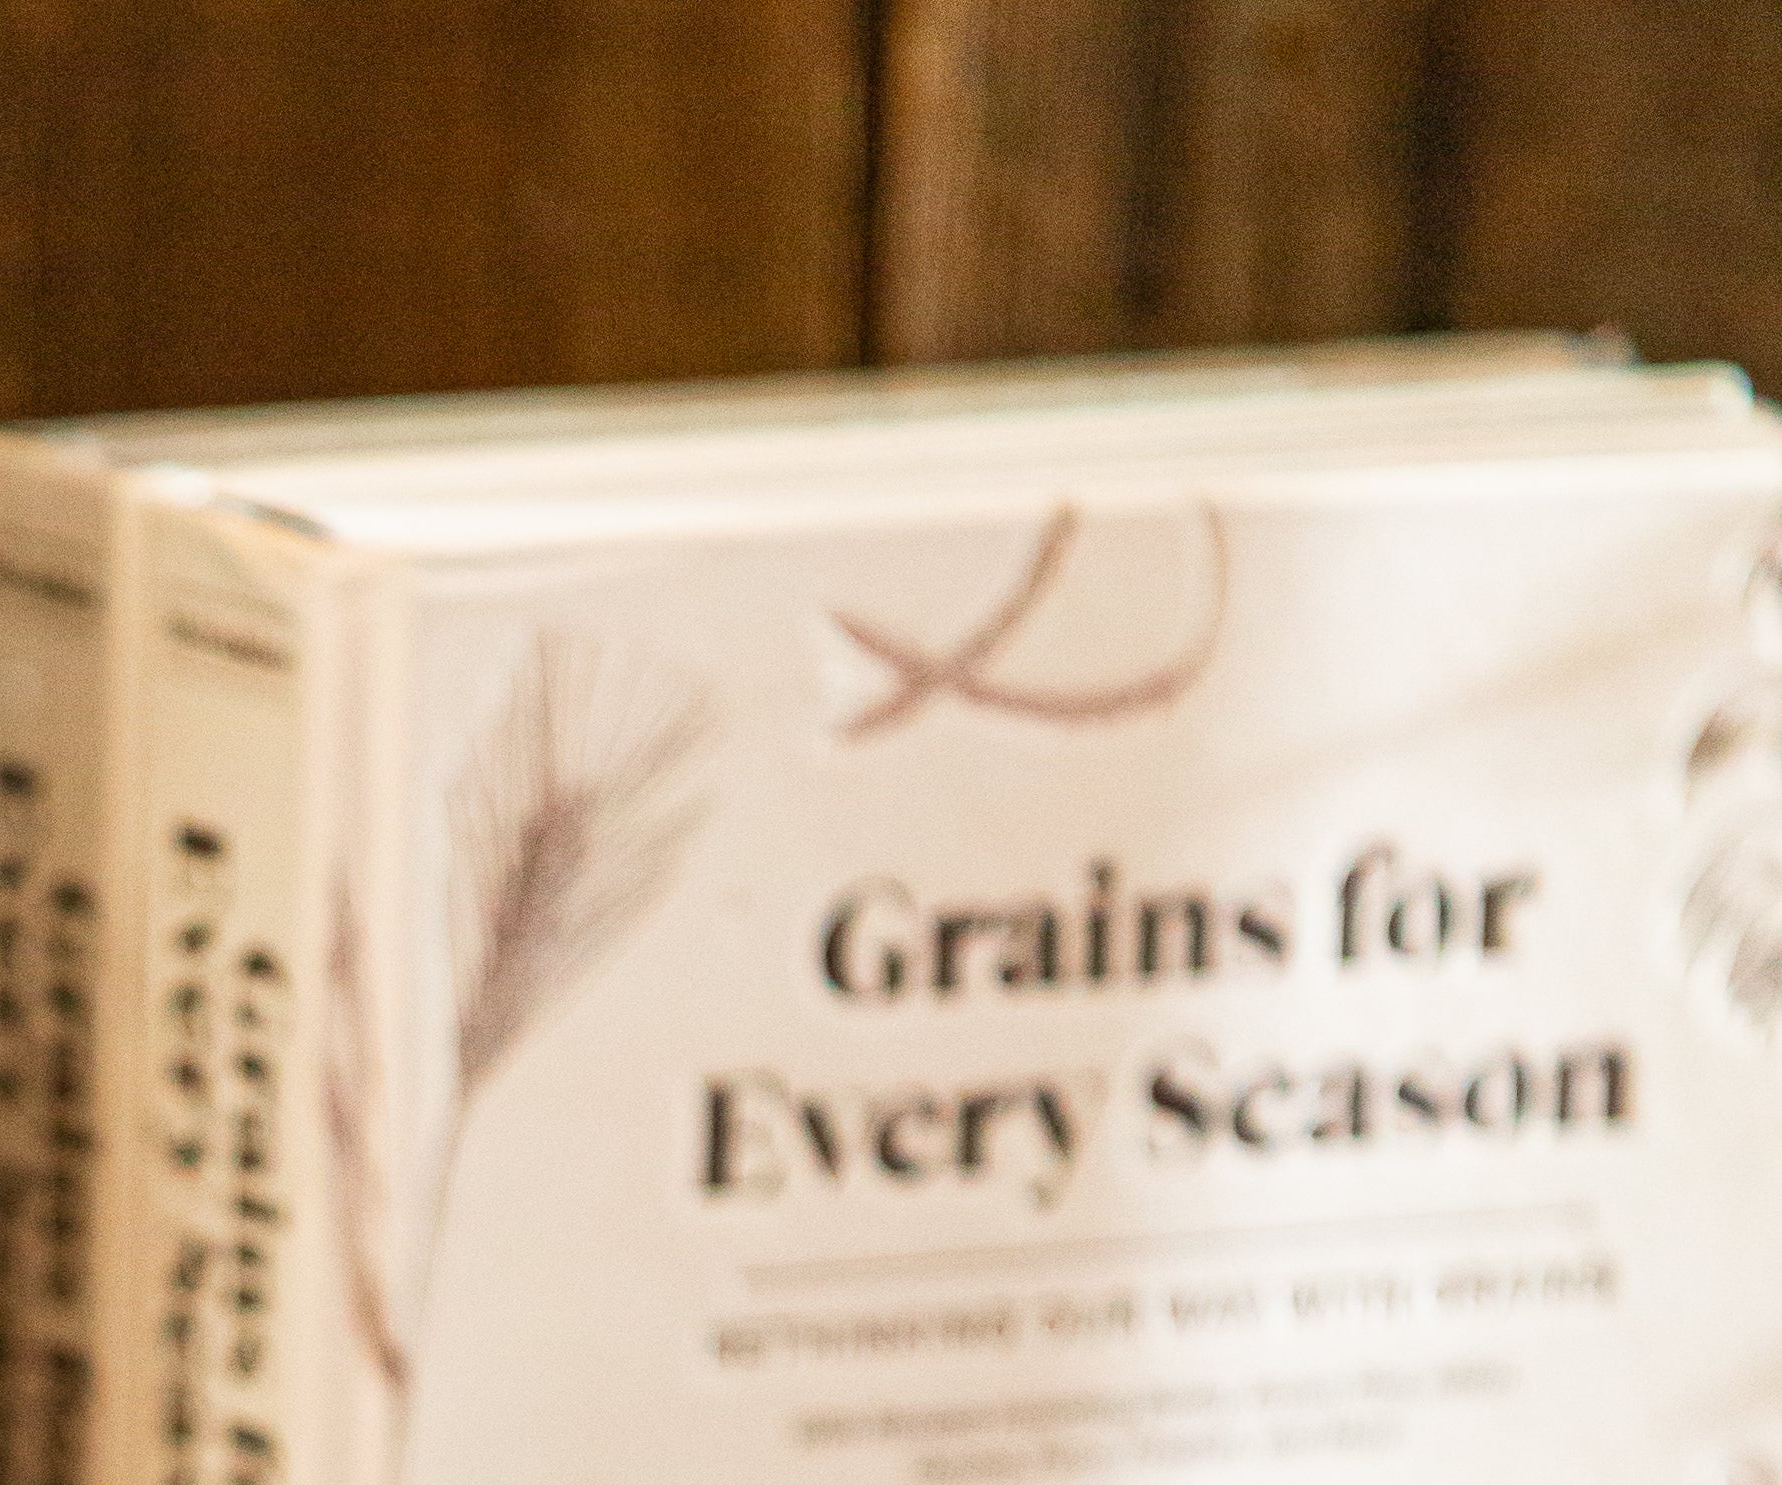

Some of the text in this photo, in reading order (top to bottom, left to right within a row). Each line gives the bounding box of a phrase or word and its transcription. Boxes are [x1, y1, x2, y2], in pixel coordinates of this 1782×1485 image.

[816, 837, 1541, 1003] Grains for
[695, 1034, 1638, 1208] Every Season
